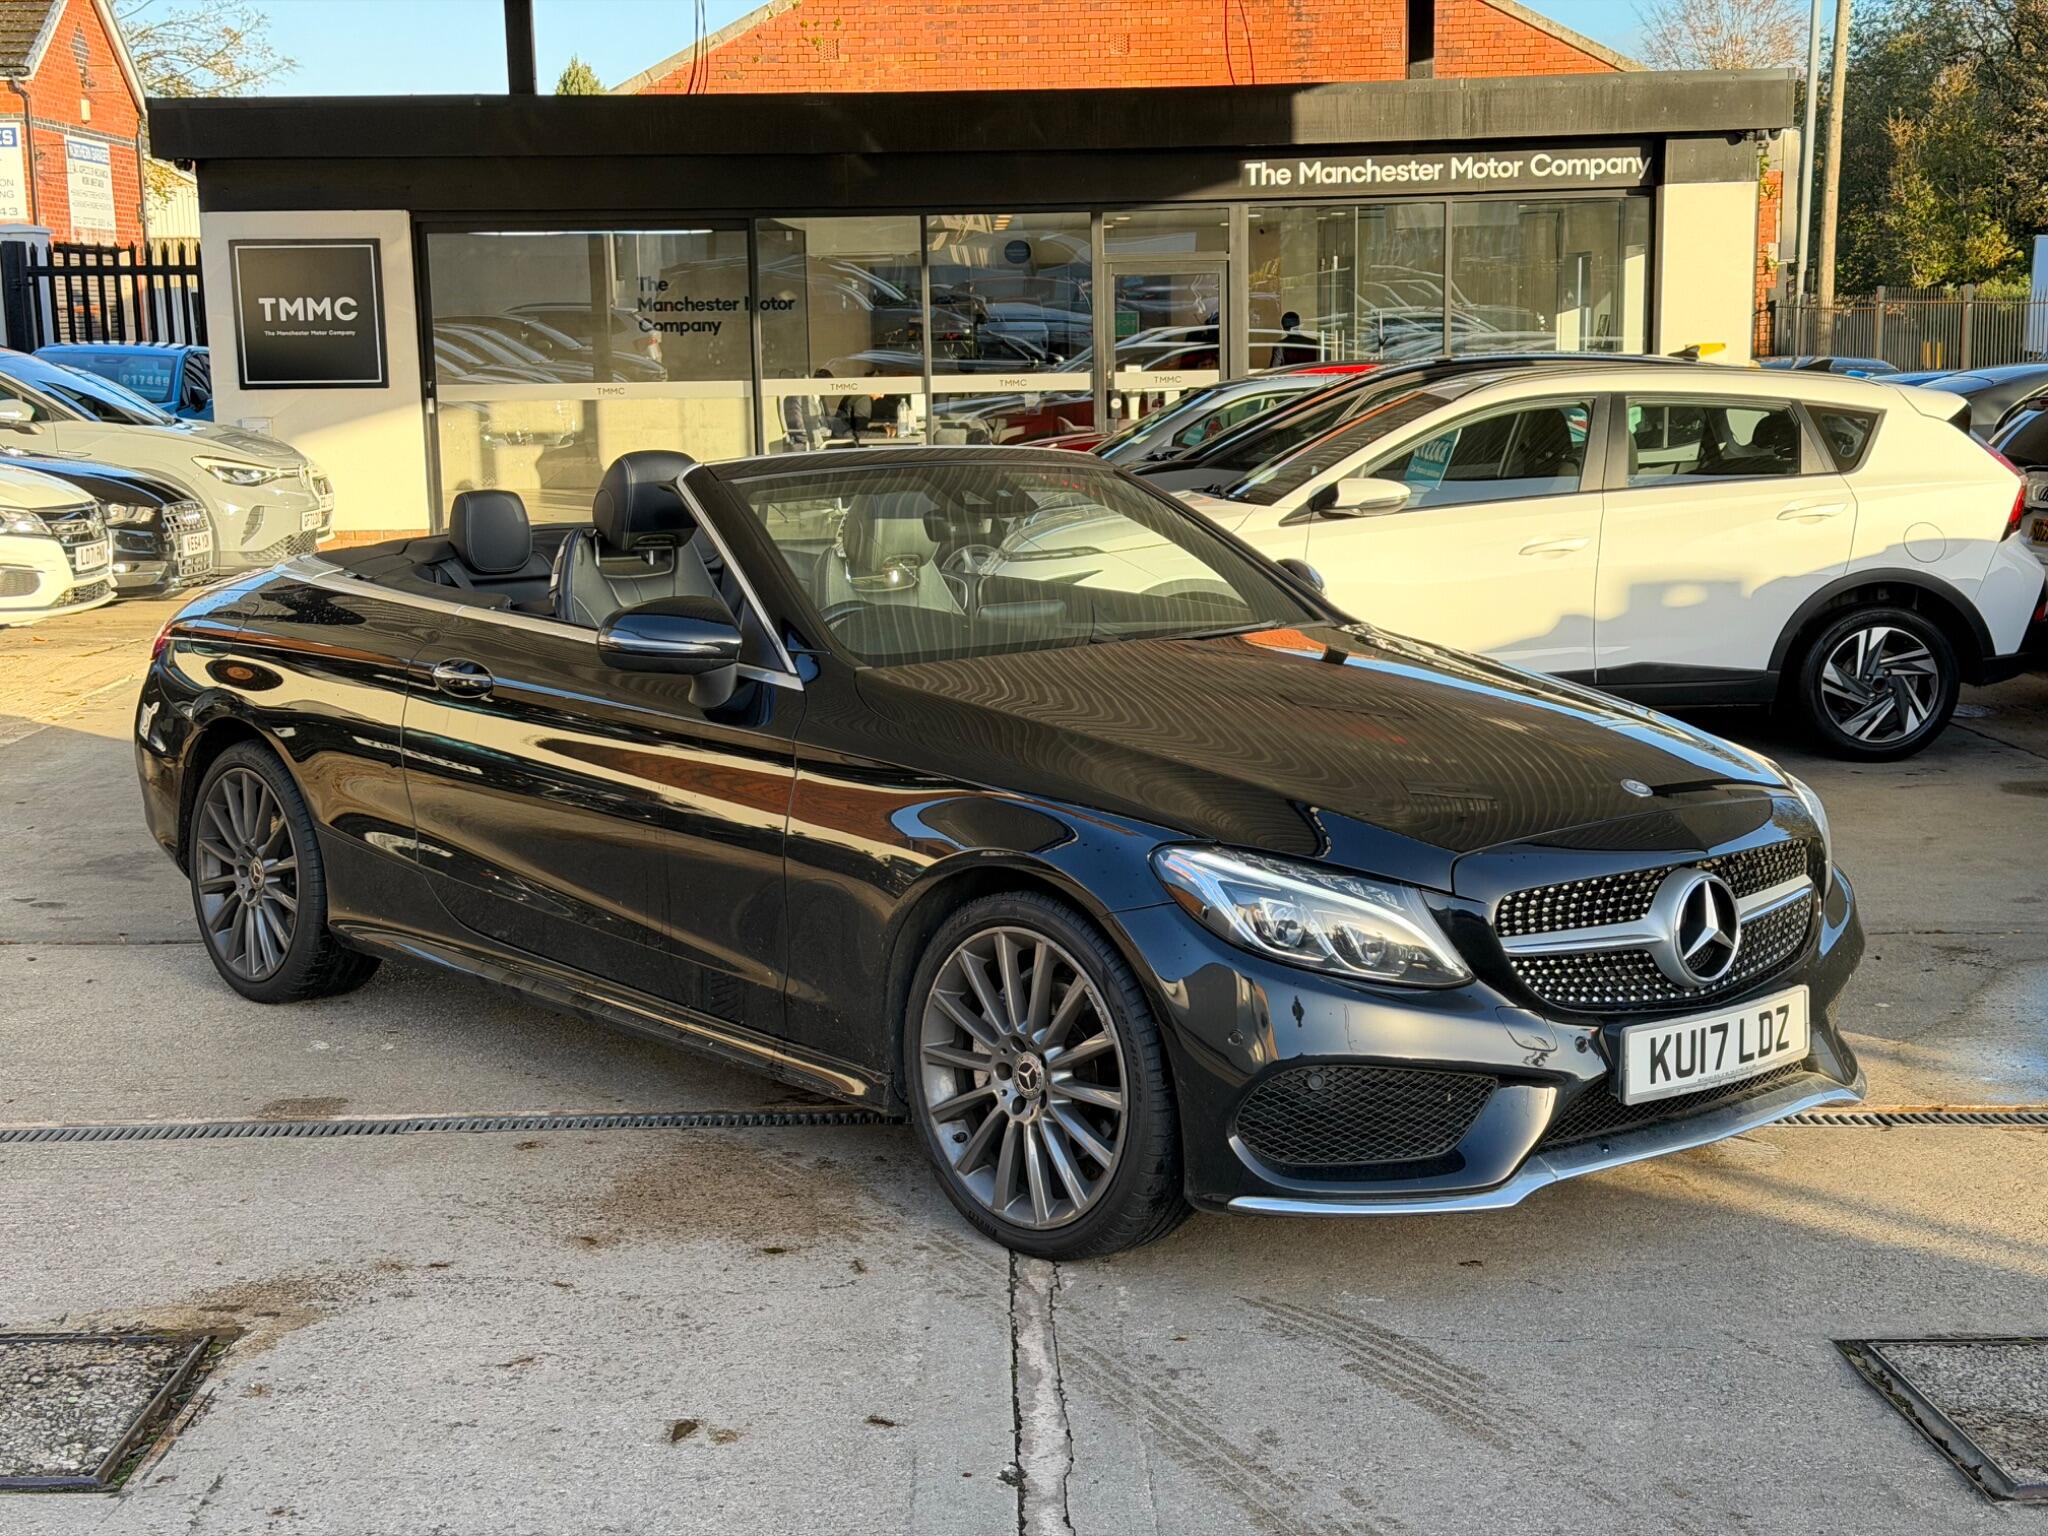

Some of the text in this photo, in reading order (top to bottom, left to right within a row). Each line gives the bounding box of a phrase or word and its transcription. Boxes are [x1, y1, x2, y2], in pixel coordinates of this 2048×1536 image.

[0, 128, 14, 146] S
[1245, 153, 1652, 187] The Manchester Motor Company
[637, 276, 668, 292] The
[258, 296, 358, 322] TMMC
[637, 296, 740, 312] Manchester
[329, 329, 356, 337] Company
[638, 317, 722, 336] Company
[829, 383, 858, 391] TMMC
[999, 378, 1027, 387] TMMC
[1153, 375, 1182, 384] TMMC
[597, 387, 626, 396] TMMC
[1650, 1003, 1790, 1084] KU17 LDZ
